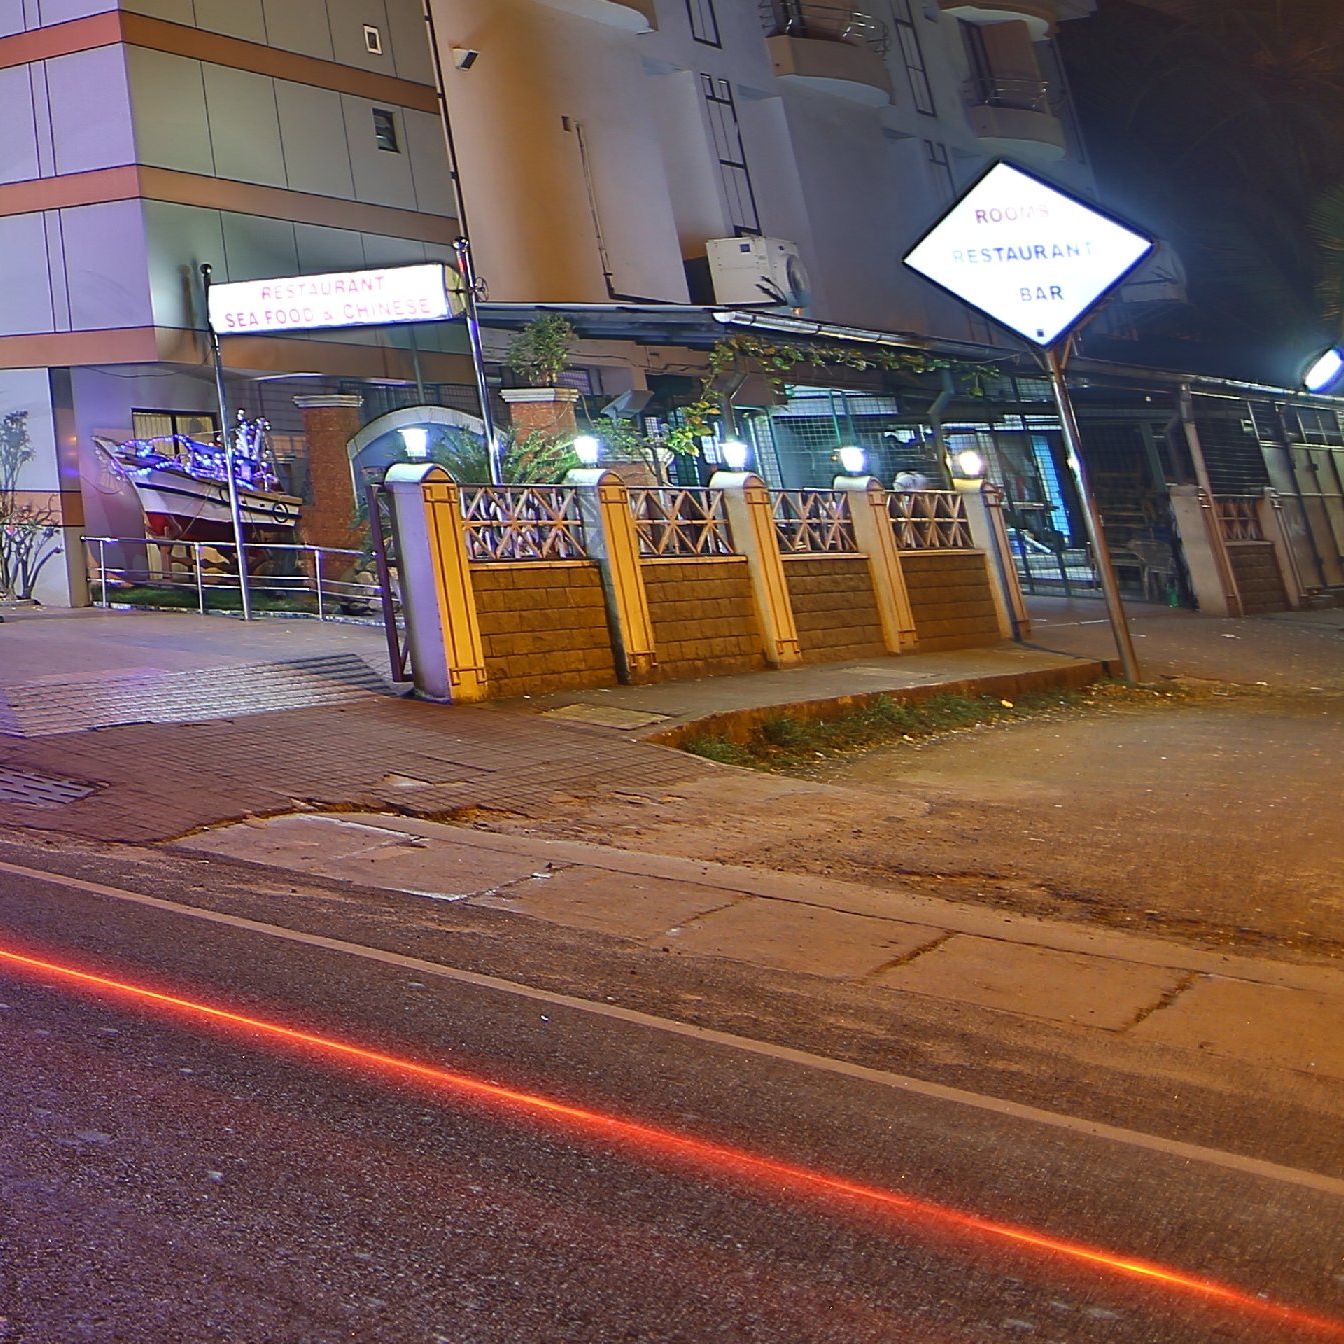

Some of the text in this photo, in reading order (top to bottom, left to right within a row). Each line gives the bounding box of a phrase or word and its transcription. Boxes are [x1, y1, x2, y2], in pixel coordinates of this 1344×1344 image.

[974, 204, 1050, 224] ROOMS
[952, 241, 1093, 264] RESTAURANT
[261, 276, 385, 301] RESTAURANT
[1019, 285, 1065, 302] BAR
[225, 311, 259, 329] SEA
[264, 307, 314, 326] FOOD
[343, 298, 432, 320] CHINESE
